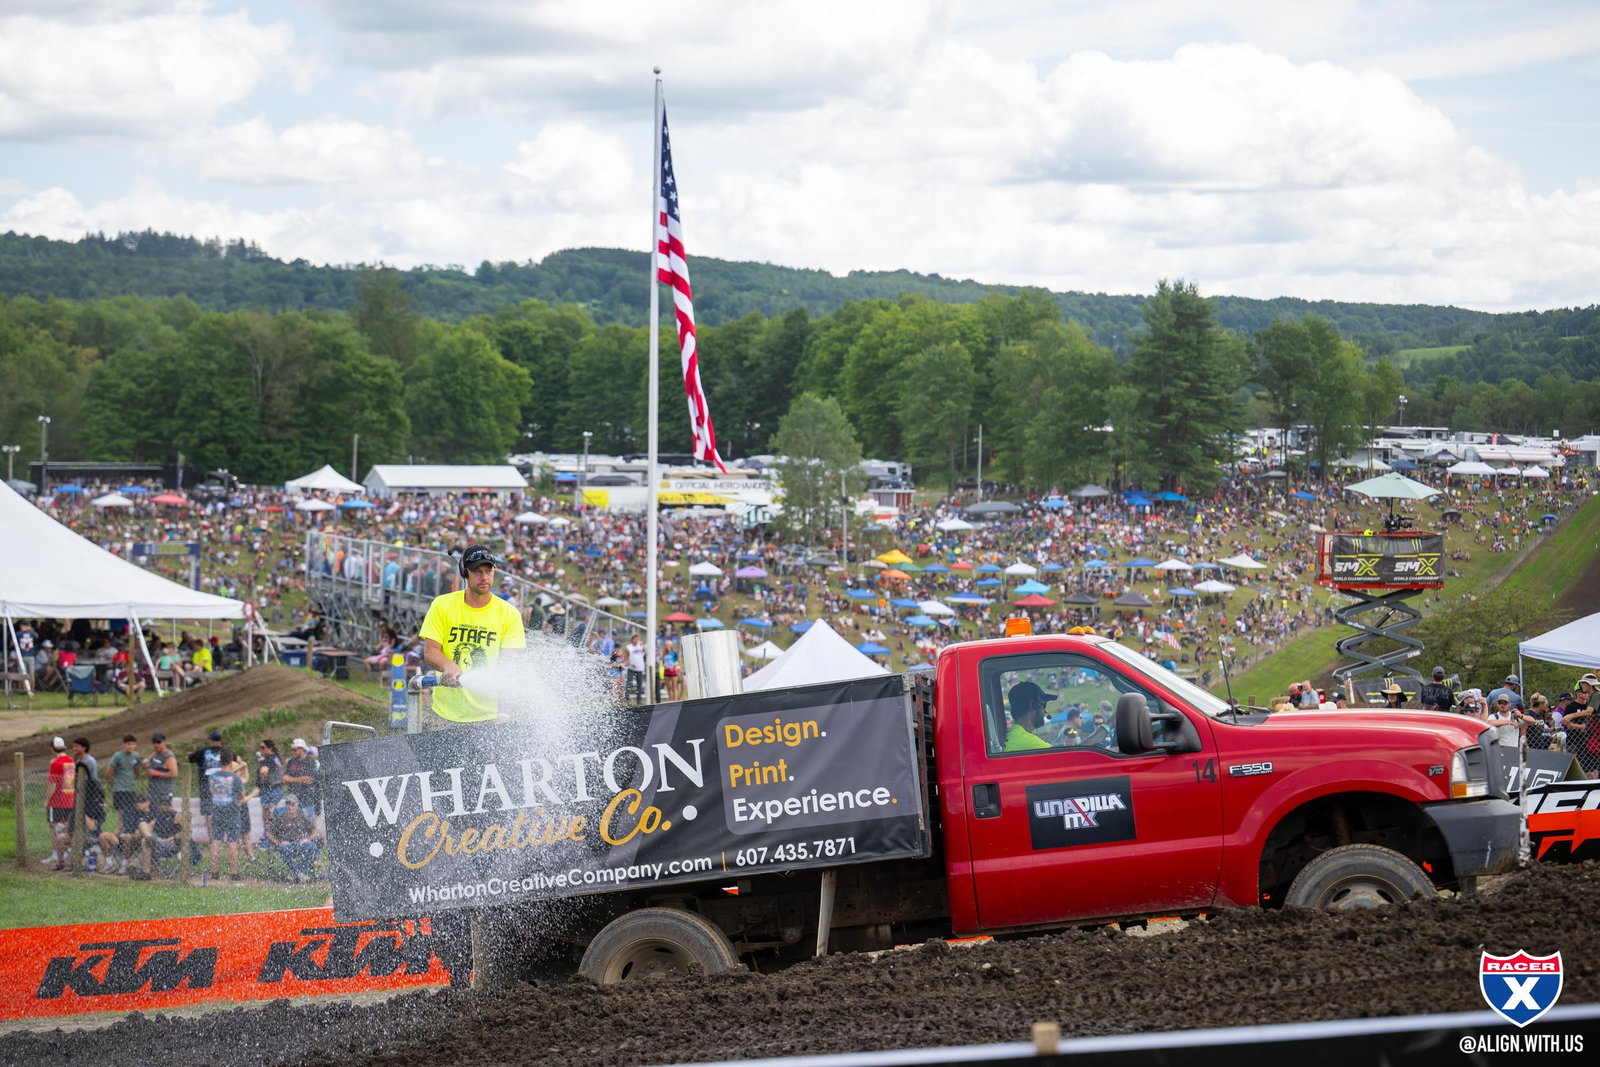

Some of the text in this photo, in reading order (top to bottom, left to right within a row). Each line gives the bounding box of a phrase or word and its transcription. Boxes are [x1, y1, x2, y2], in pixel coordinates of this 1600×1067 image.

[675, 481, 709, 490] OFFICIAL
[1334, 558, 1380, 576] SMX
[1394, 557, 1439, 576] SMX
[448, 627, 497, 647] STAFF
[724, 718, 828, 748] Design.
[342, 738, 705, 829] WHARTON
[729, 758, 795, 788] Print.
[1192, 759, 1217, 784] 14
[1428, 765, 1445, 776] V10
[733, 786, 898, 824] Experience.
[397, 788, 673, 869] Creative Co.
[409, 837, 857, 903] WhartonCreativeCompany.com 607.435.7871
[36, 938, 218, 1000] KTM
[257, 925, 431, 983] KTM
